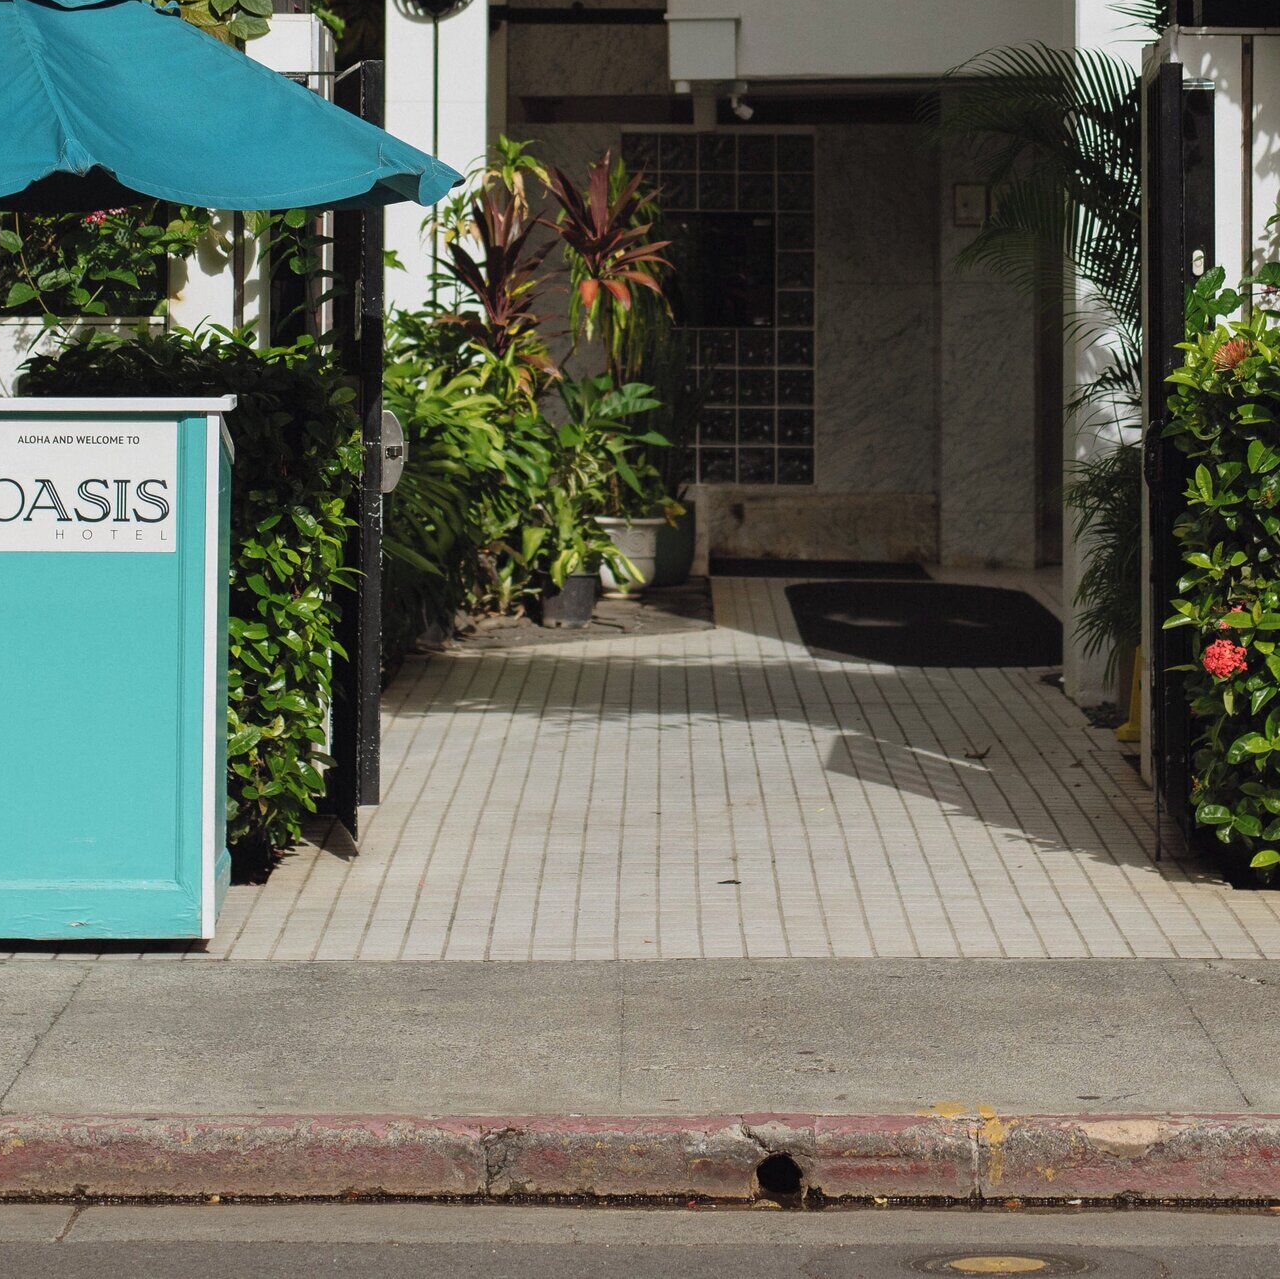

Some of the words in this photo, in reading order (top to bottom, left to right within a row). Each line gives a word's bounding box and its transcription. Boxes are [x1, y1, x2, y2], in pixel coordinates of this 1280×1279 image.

[17, 435, 51, 445] ALOHA
[52, 435, 74, 445] AND
[75, 435, 124, 445] WELCOME
[126, 435, 140, 445] TO
[55, 529, 167, 541] HOTEL
